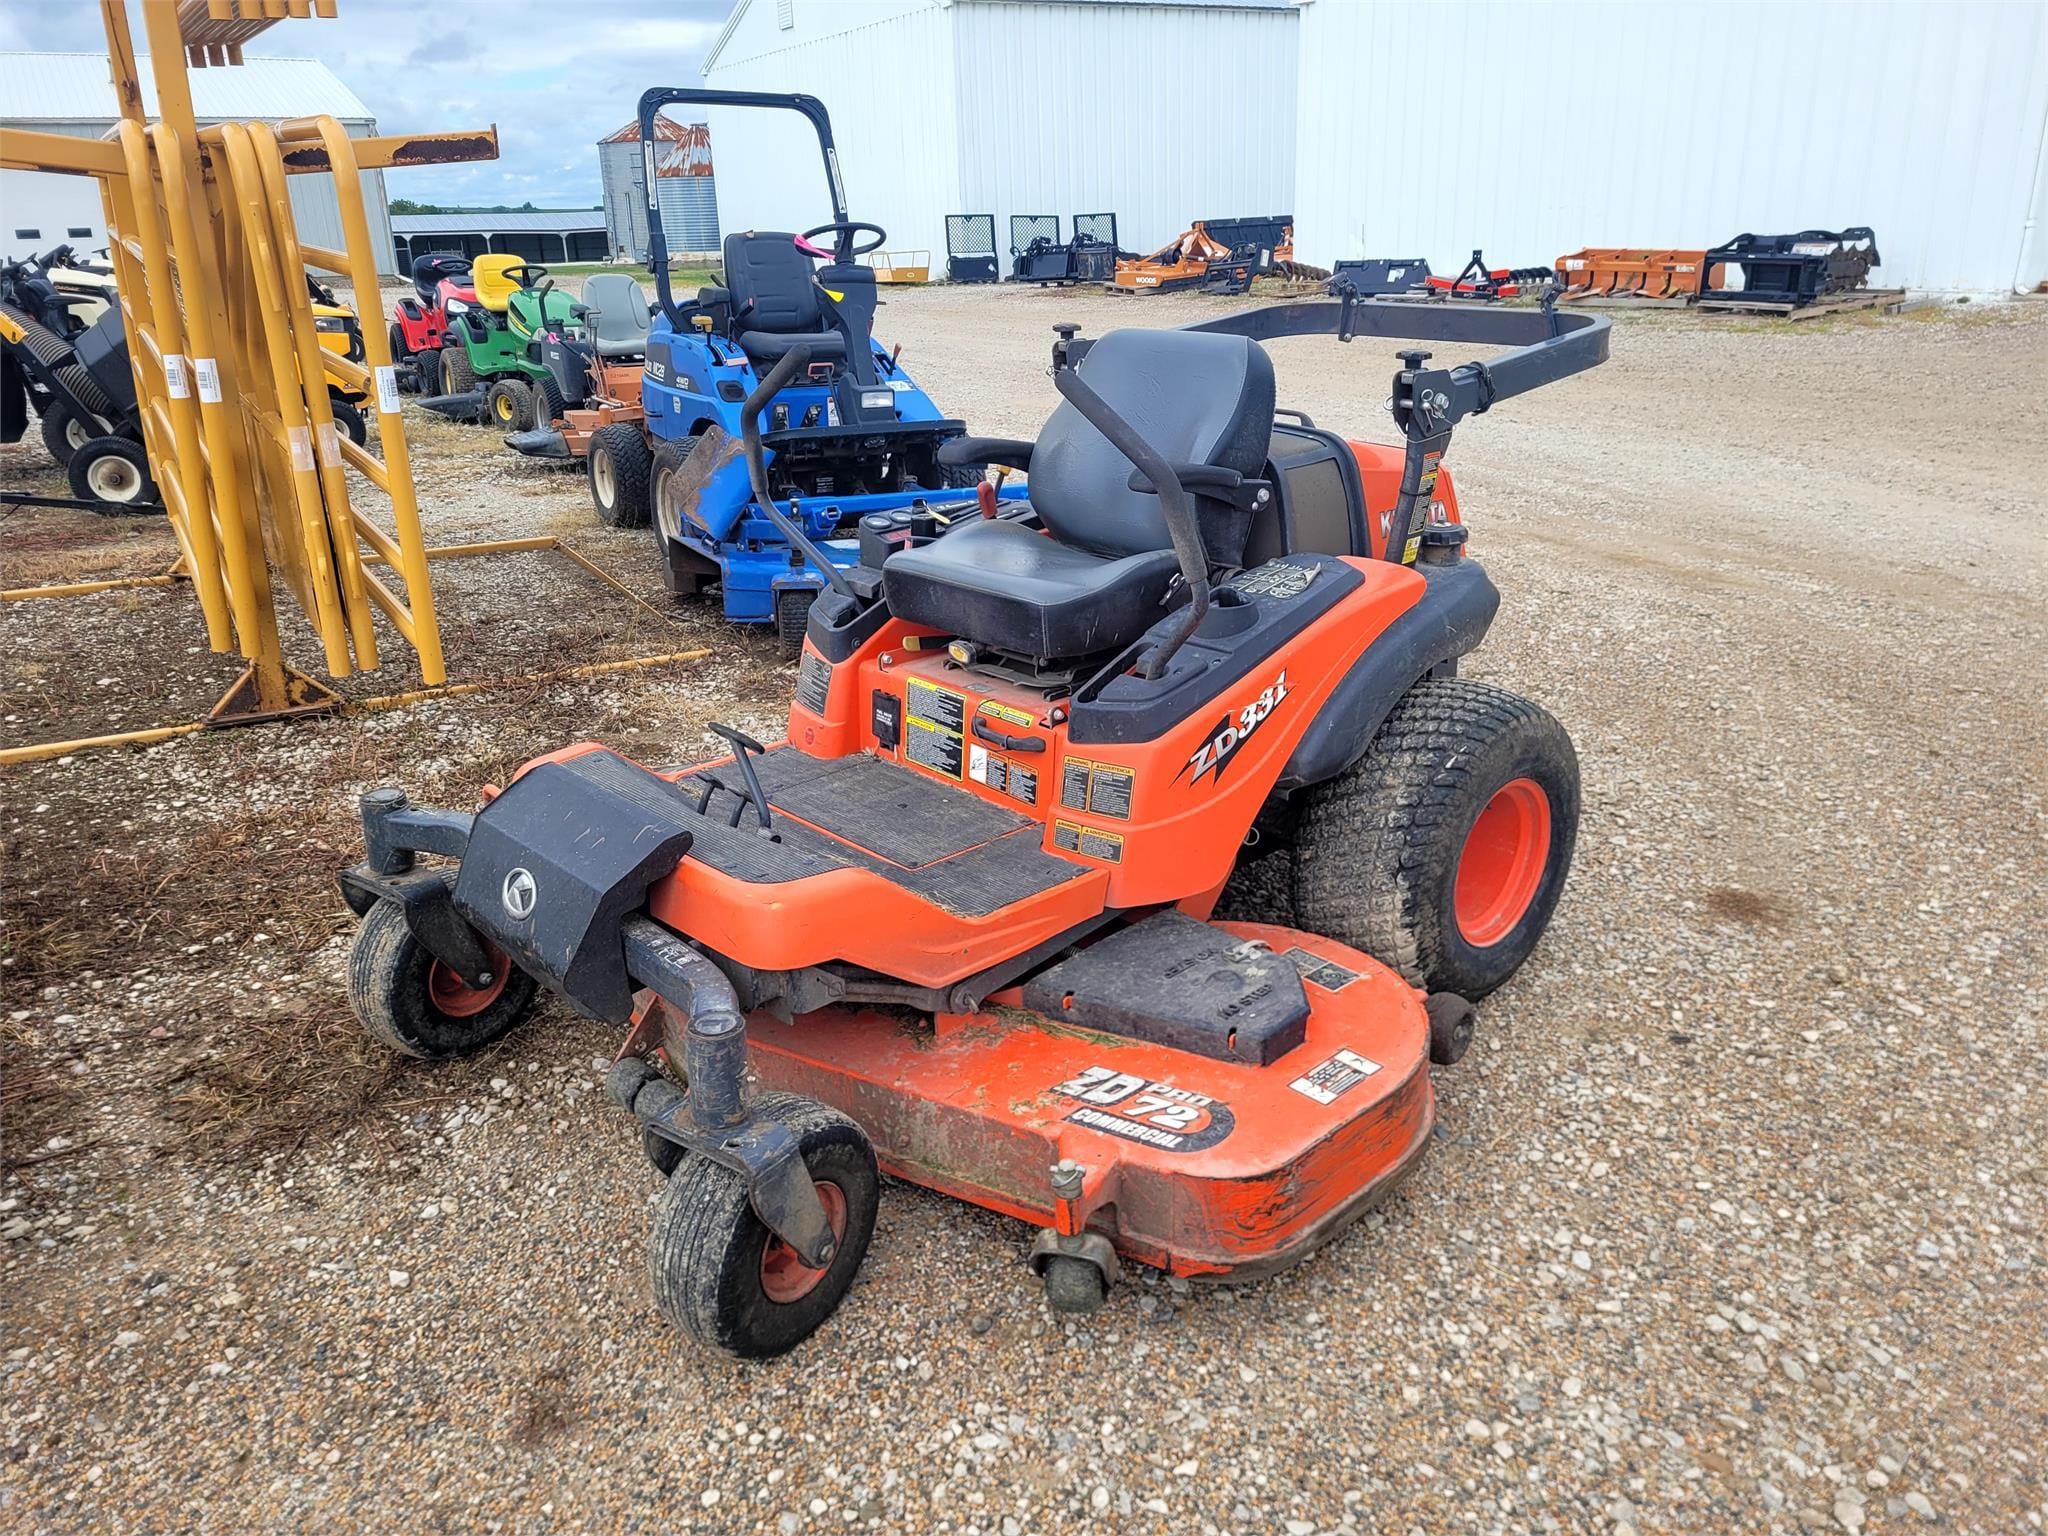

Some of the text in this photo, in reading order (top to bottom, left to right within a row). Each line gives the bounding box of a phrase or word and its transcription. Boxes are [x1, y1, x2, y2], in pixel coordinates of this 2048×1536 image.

[1380, 501, 1448, 538] KTA
[1051, 1065, 1213, 1108] ZD PRO
[1070, 1106, 1184, 1149] COMMERCIAL
[1122, 1095, 1200, 1129] 72
